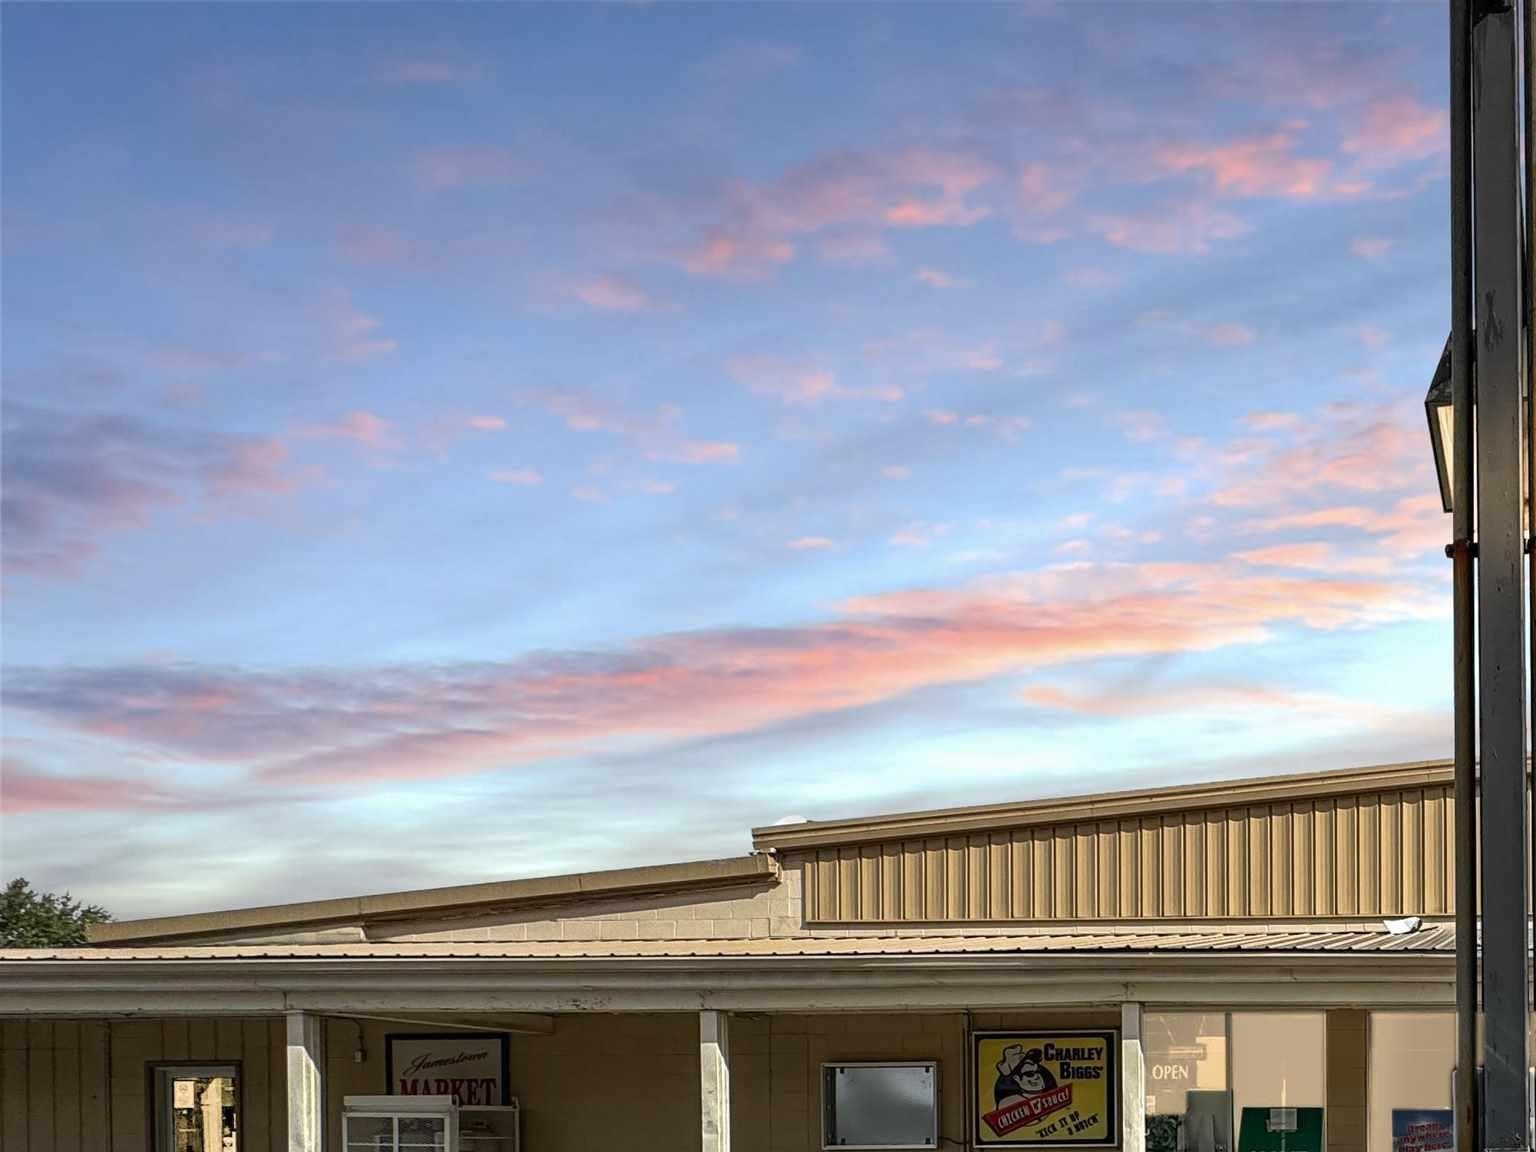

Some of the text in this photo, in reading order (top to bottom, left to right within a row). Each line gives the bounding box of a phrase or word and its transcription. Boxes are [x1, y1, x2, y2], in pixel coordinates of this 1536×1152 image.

[402, 1051, 489, 1076] Jamestown
[1043, 1042, 1104, 1061] CHARLEY
[1151, 1064, 1190, 1081] OPEN
[400, 1078, 497, 1106] MARKET
[998, 1105, 1030, 1129] CHICKEN
